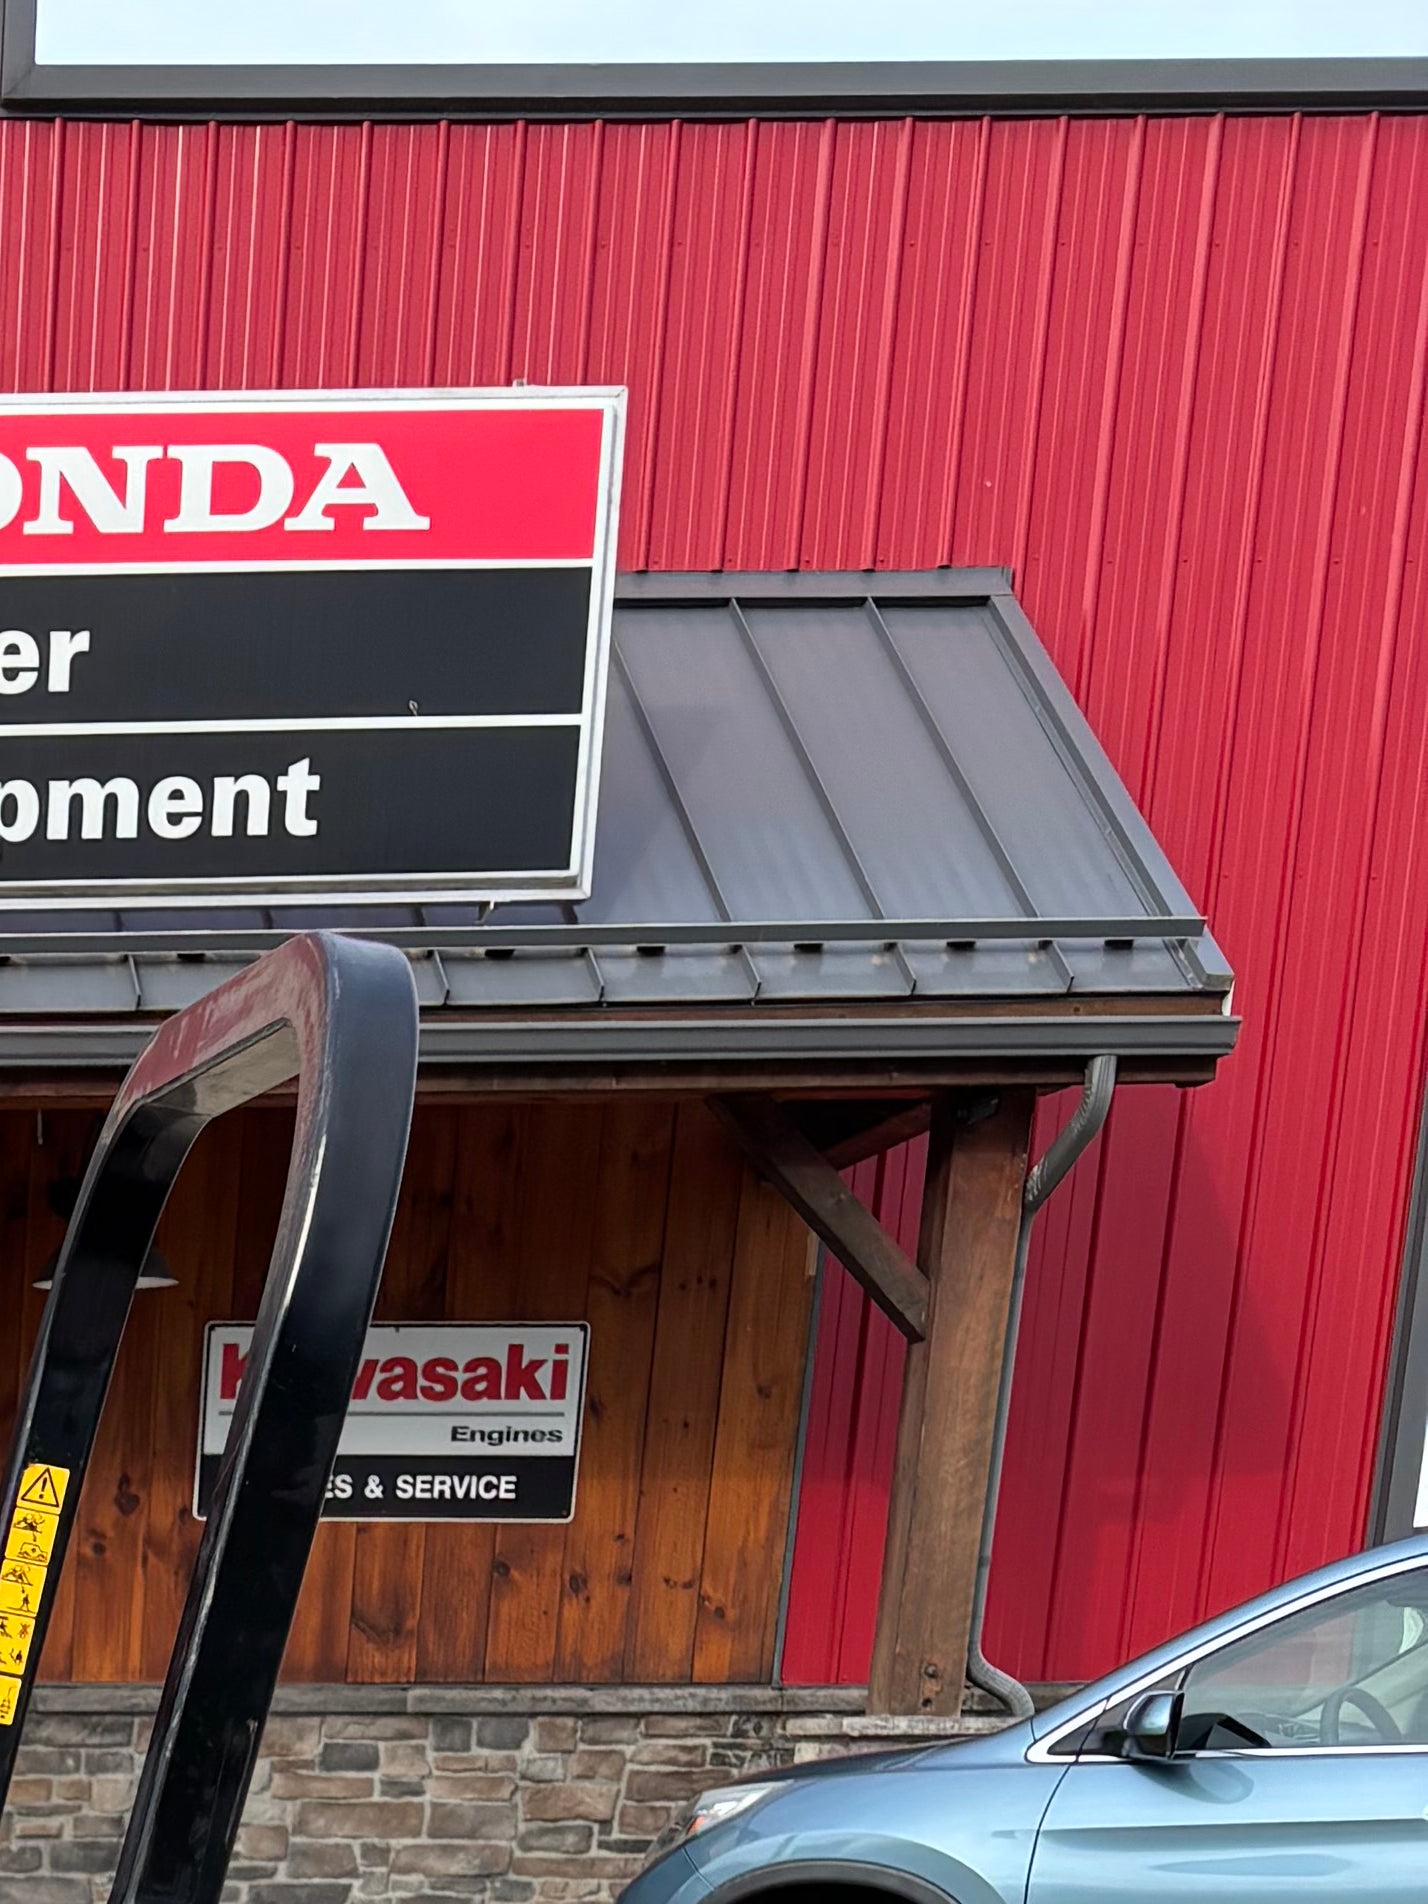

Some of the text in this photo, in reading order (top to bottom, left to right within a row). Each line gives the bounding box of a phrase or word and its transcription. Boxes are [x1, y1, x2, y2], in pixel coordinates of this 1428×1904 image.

[450, 1426, 564, 1446] Engines
[363, 1474, 384, 1499] &
[395, 1475, 518, 1500] SERVICE
